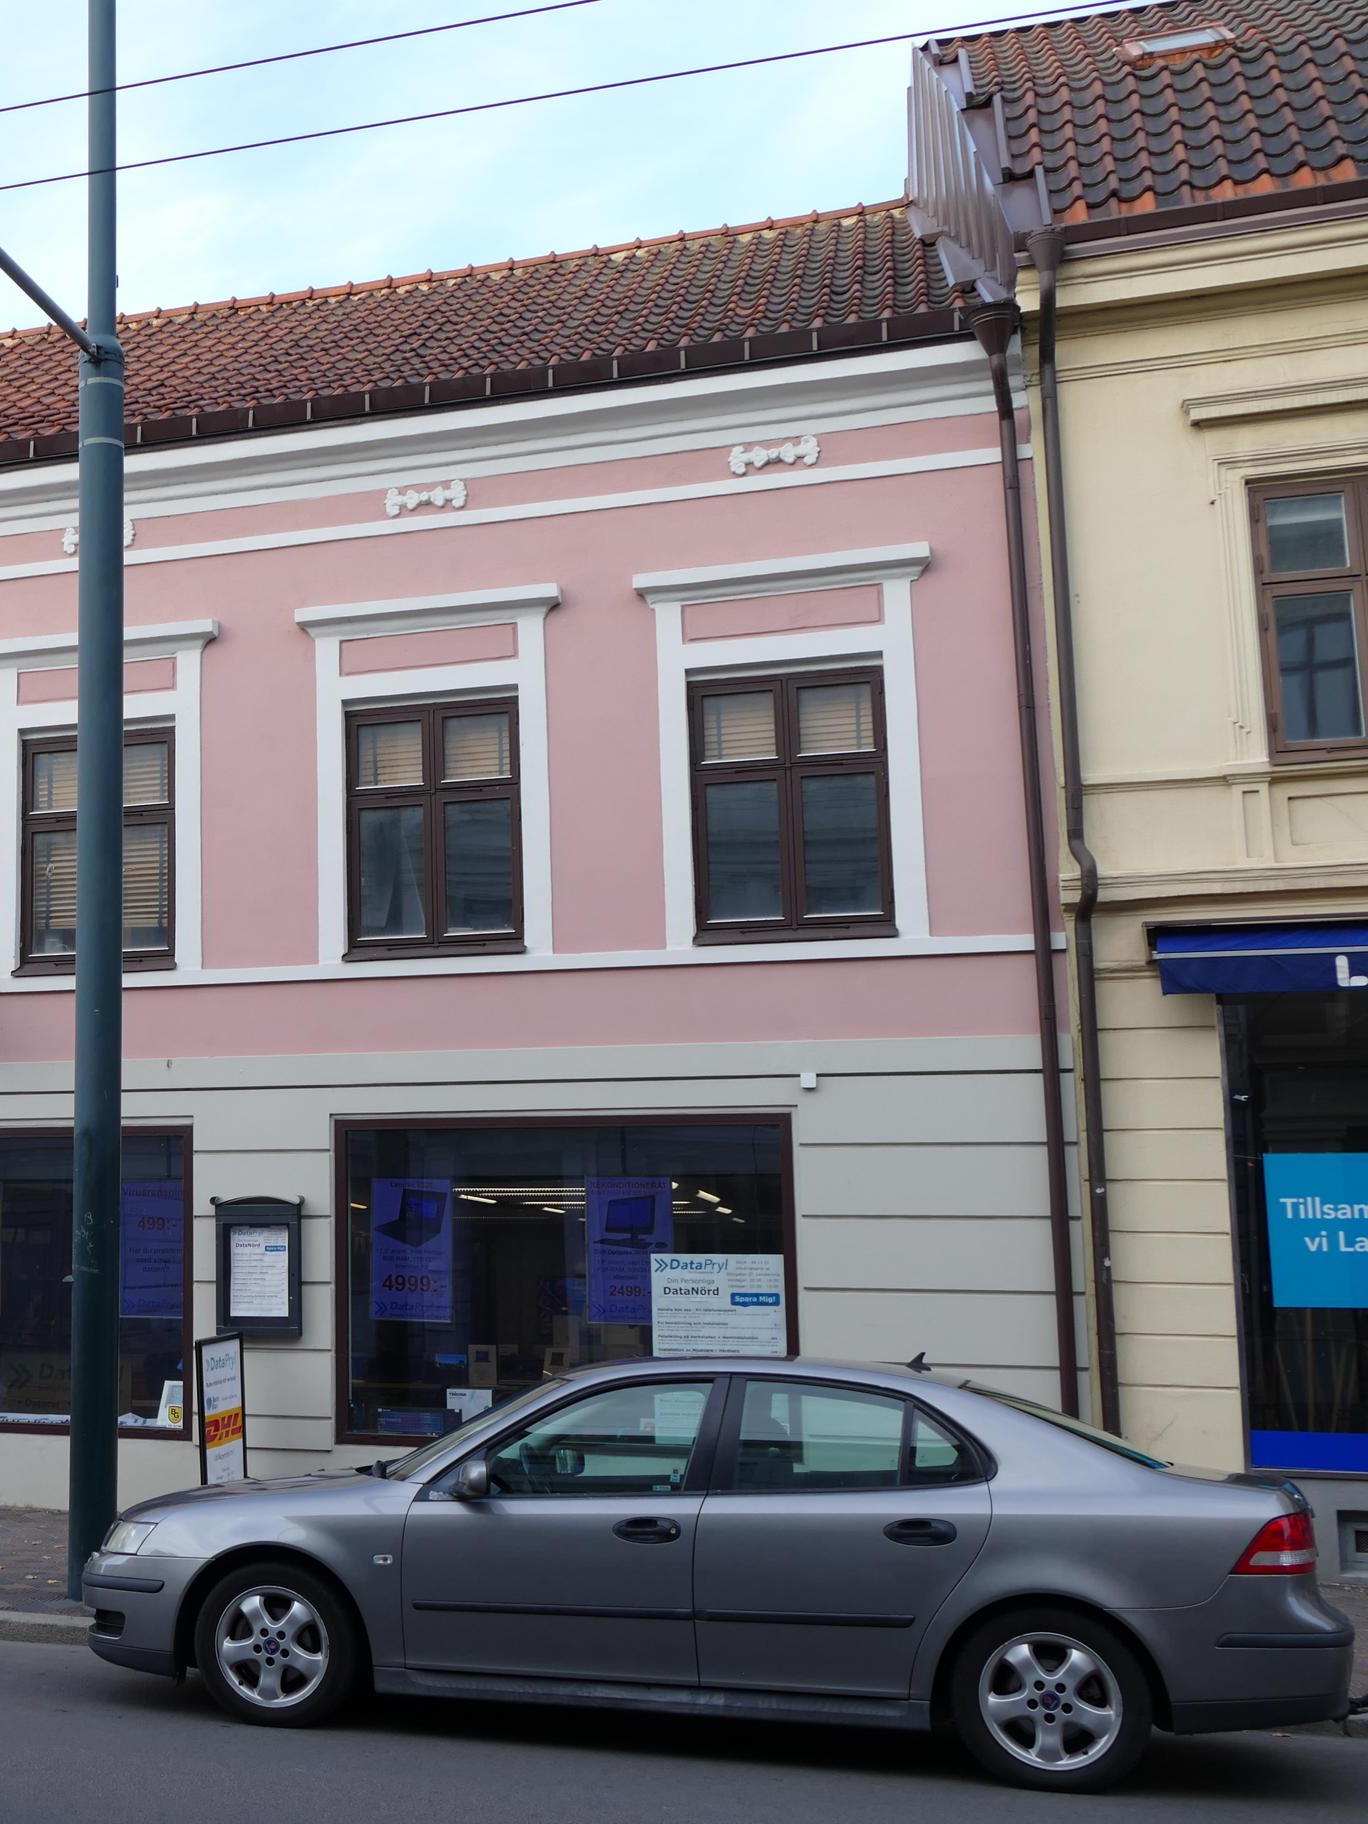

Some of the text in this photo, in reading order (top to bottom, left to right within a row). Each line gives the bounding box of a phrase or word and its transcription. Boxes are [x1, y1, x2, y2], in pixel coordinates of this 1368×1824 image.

[137, 1216, 177, 1231] 499:-
[1304, 1231, 1329, 1252] vi
[670, 1259, 729, 1273] DataPryl
[382, 1273, 447, 1293] 4999:-
[663, 1286, 720, 1296] DataNörd
[205, 1413, 242, 1443] DHL
